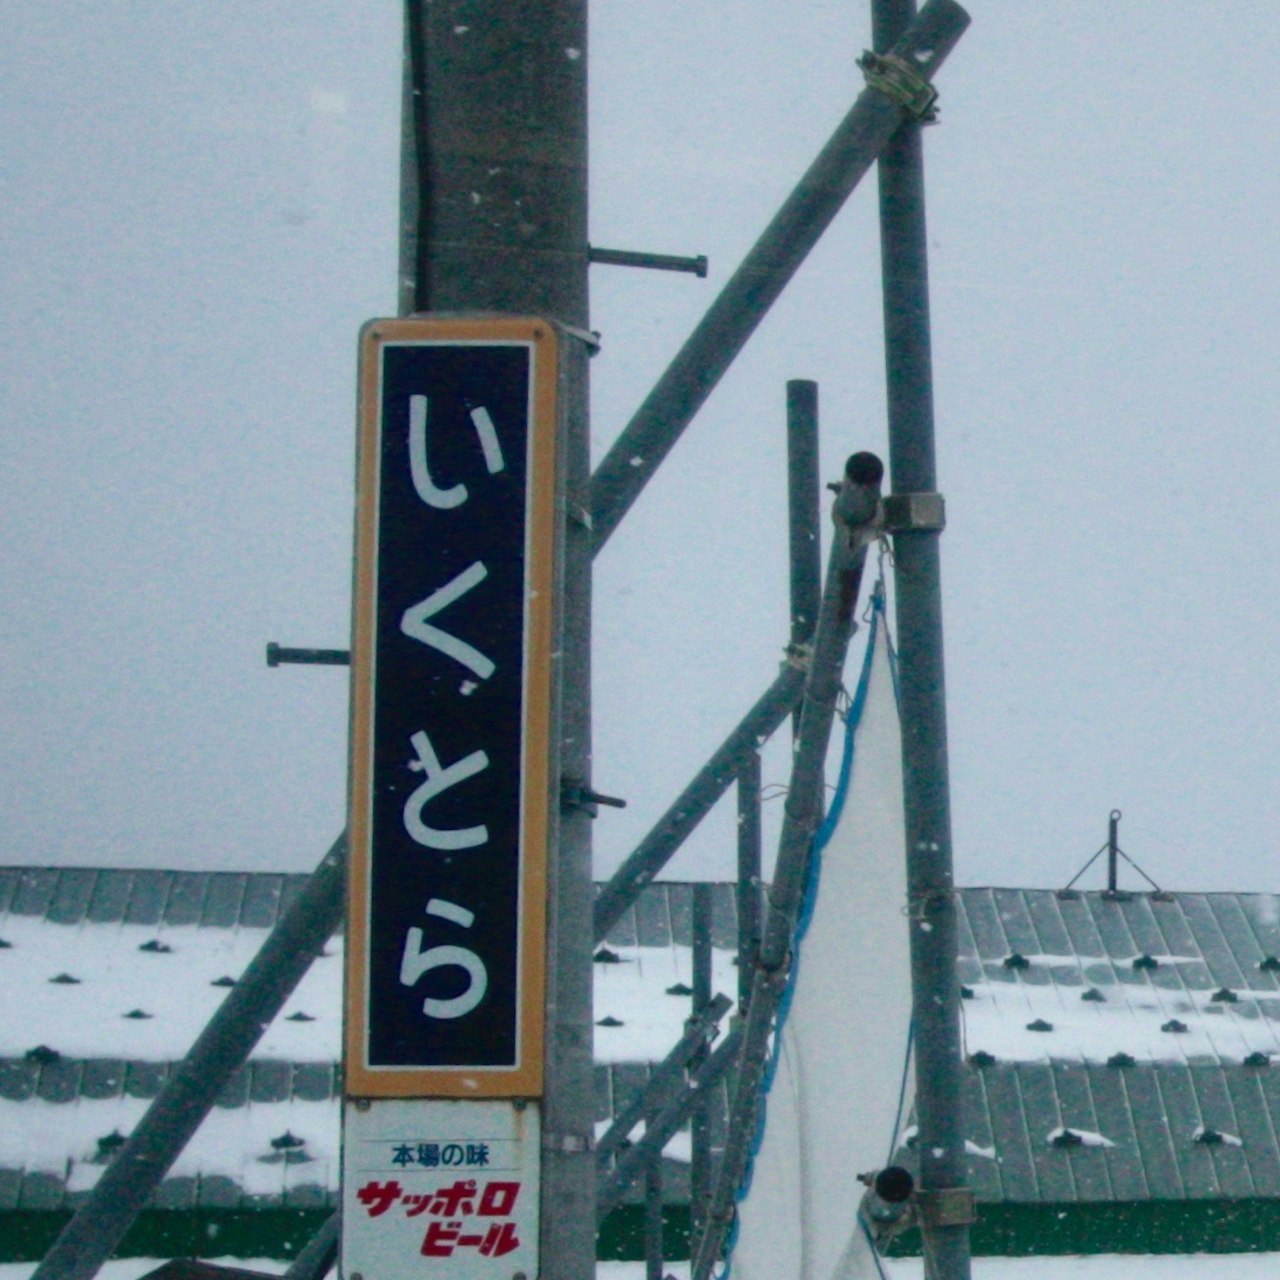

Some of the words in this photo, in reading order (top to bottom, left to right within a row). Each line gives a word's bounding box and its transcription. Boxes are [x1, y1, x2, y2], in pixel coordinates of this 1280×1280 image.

[400, 394, 505, 1019] いくとら
[392, 1143, 489, 1167] 本場の味
[357, 1179, 521, 1217] サッポロ
[420, 1222, 520, 1257] ビール
